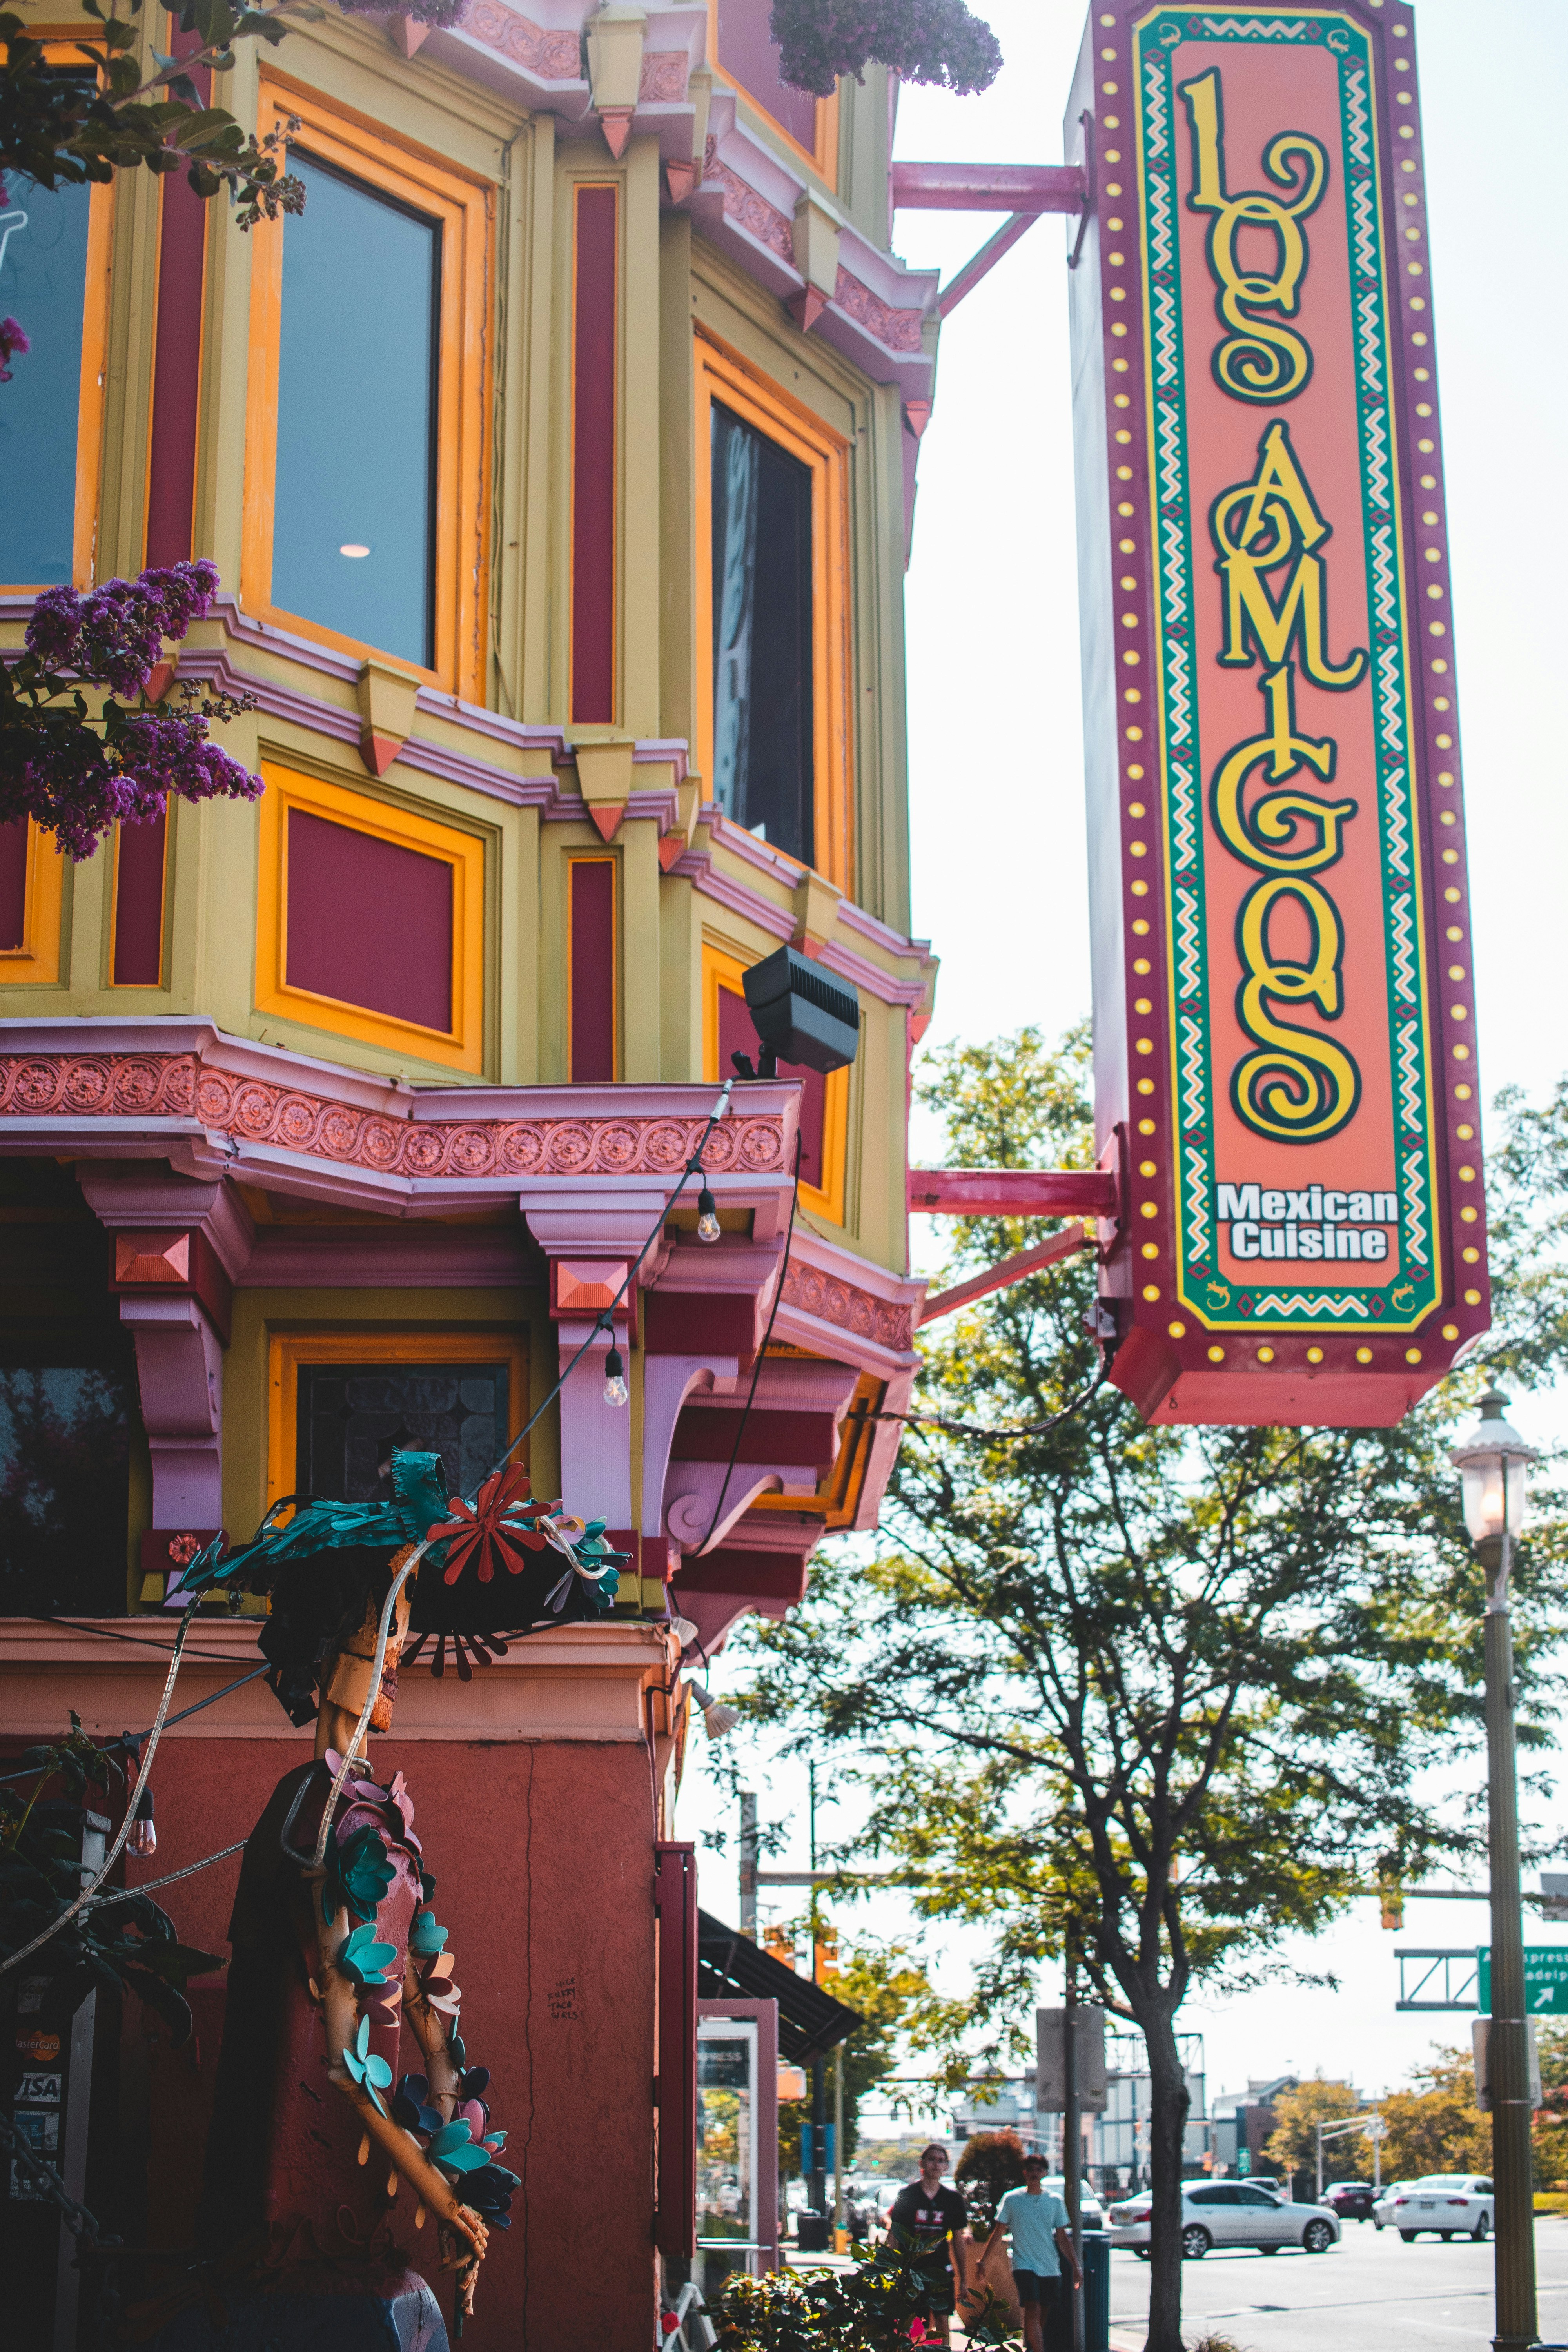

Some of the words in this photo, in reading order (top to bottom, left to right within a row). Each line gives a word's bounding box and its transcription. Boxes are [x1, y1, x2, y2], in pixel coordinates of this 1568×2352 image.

[1177, 65, 1330, 406] LOS
[1208, 418, 1370, 1145] AMIGOS
[1216, 1183, 1399, 1224] Mexican
[1230, 1221, 1388, 1261] Cuisine
[16, 2038, 60, 2050] asterCard
